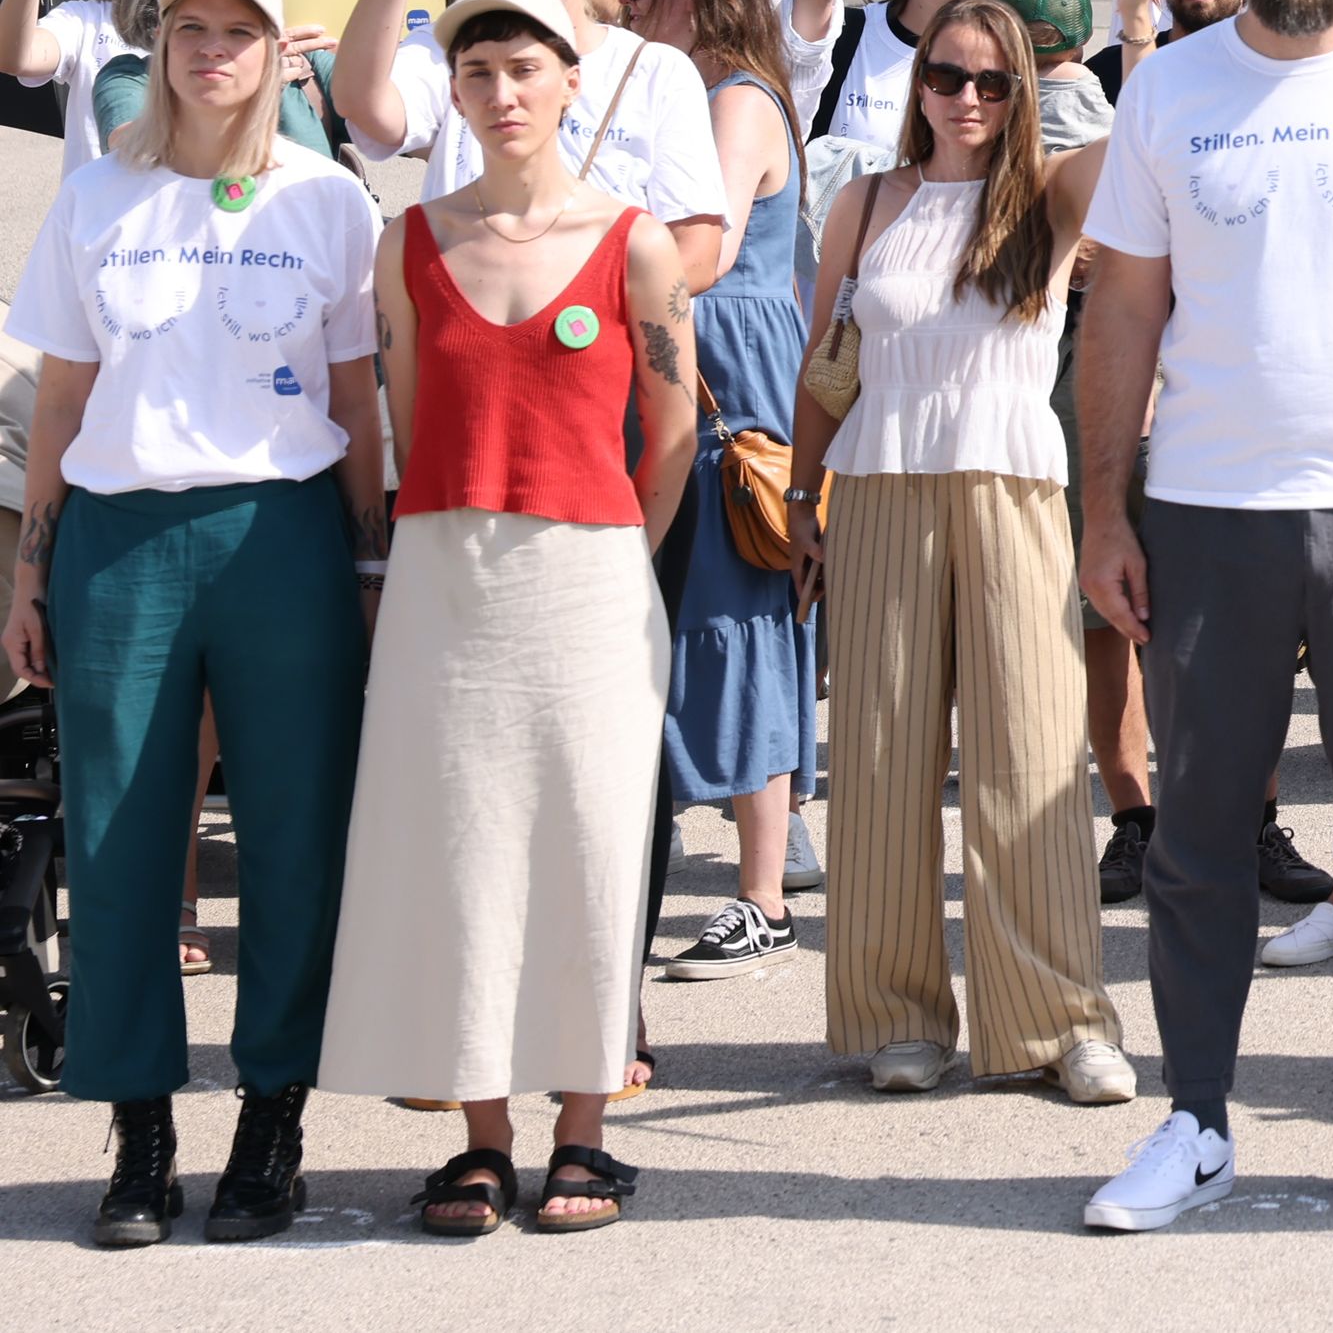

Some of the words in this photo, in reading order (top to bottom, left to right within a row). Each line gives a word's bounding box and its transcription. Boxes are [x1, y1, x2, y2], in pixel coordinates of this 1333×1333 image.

[845, 93, 899, 111] Stillen.
[1190, 133, 1264, 154] Stillen.
[1272, 123, 1329, 143] Mein
[1315, 163, 1329, 186] Ich
[1189, 175, 1201, 199] Ich
[1195, 201, 1218, 226] still,
[1225, 215, 1247, 226] wo
[1250, 197, 1271, 218] ich
[1267, 165, 1280, 193] will.
[178, 246, 233, 264] Mein
[217, 286, 229, 310] Ich
[294, 293, 308, 319] will.
[96, 290, 106, 313] Ich
[101, 315, 123, 340] still,
[129, 330, 151, 341] wo
[156, 317, 177, 335] ich
[221, 314, 242, 340] still,
[248, 332, 271, 342] wo
[273, 321, 296, 339] ich
